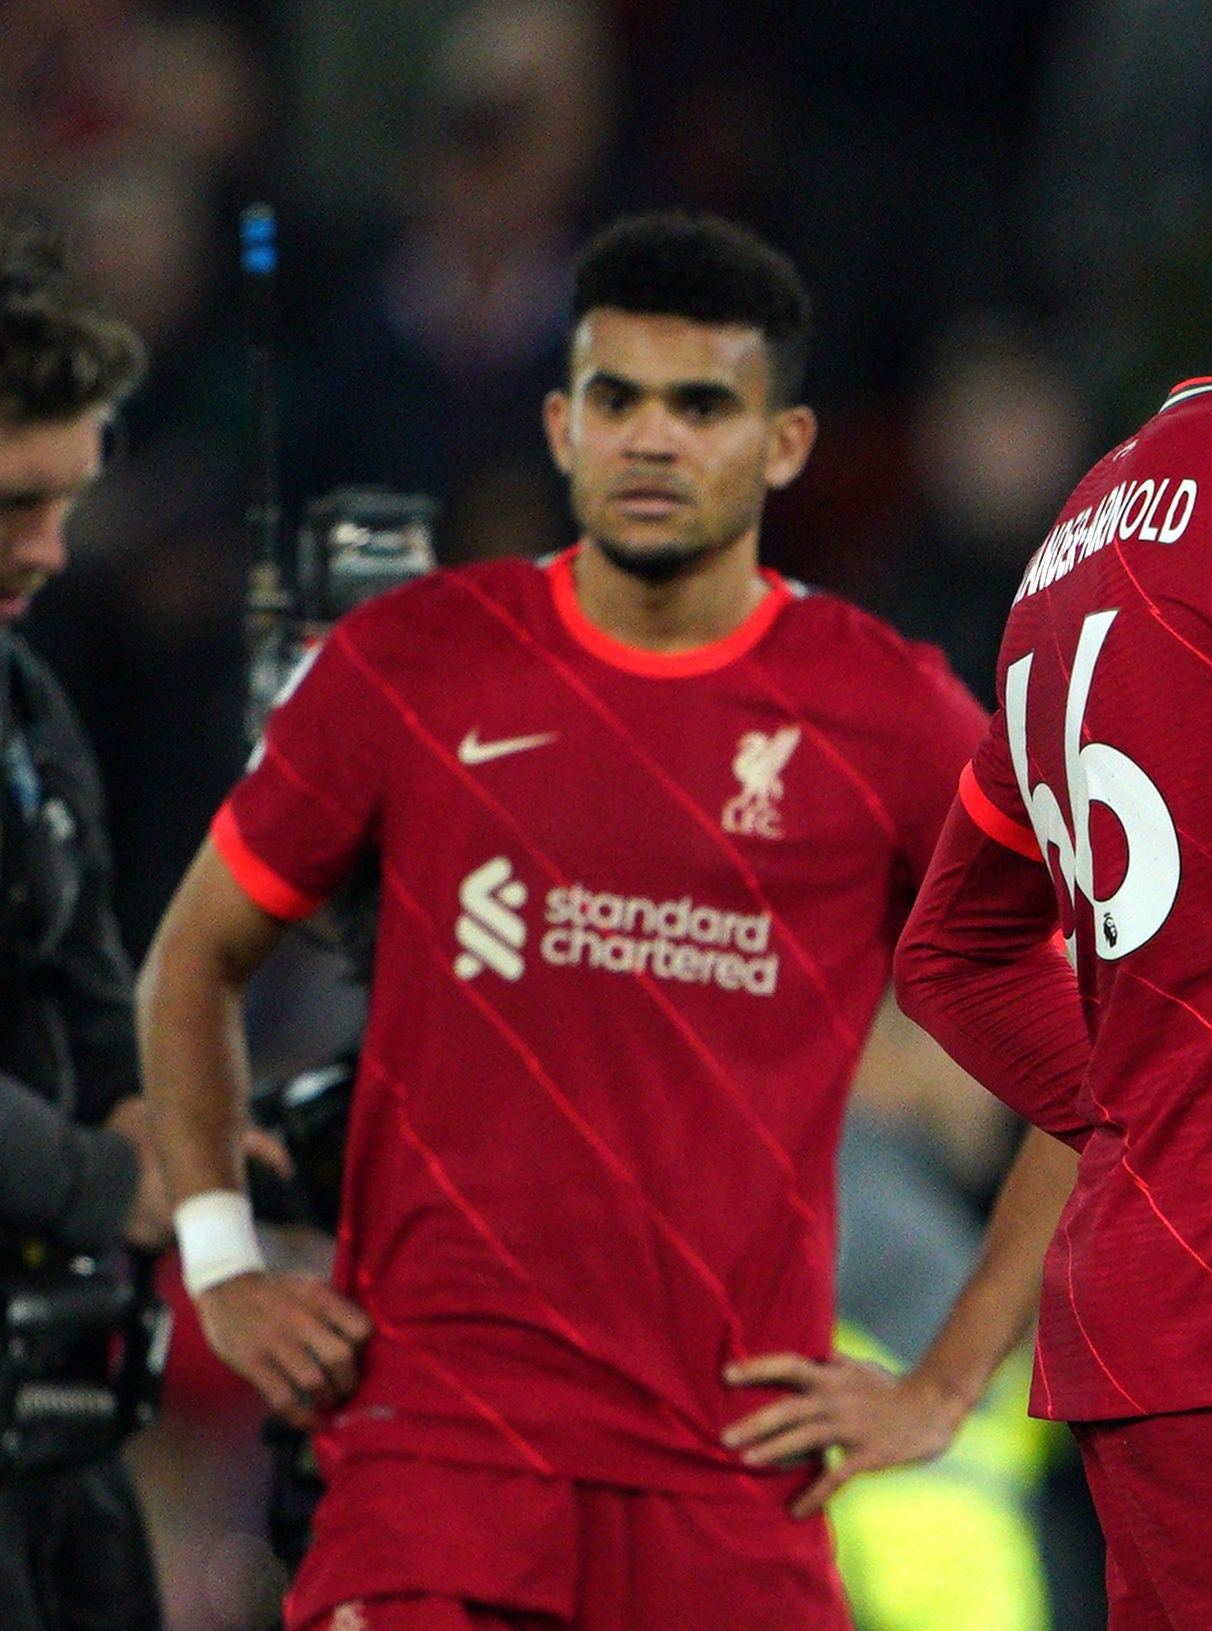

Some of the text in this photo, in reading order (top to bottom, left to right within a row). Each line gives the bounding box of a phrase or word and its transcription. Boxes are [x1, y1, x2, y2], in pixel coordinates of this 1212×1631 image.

[1011, 479, 1197, 609] ANDER-ARNOLD
[1005, 608, 1182, 962] 66
[540, 926, 779, 996] chartered
[544, 883, 772, 952] standard
